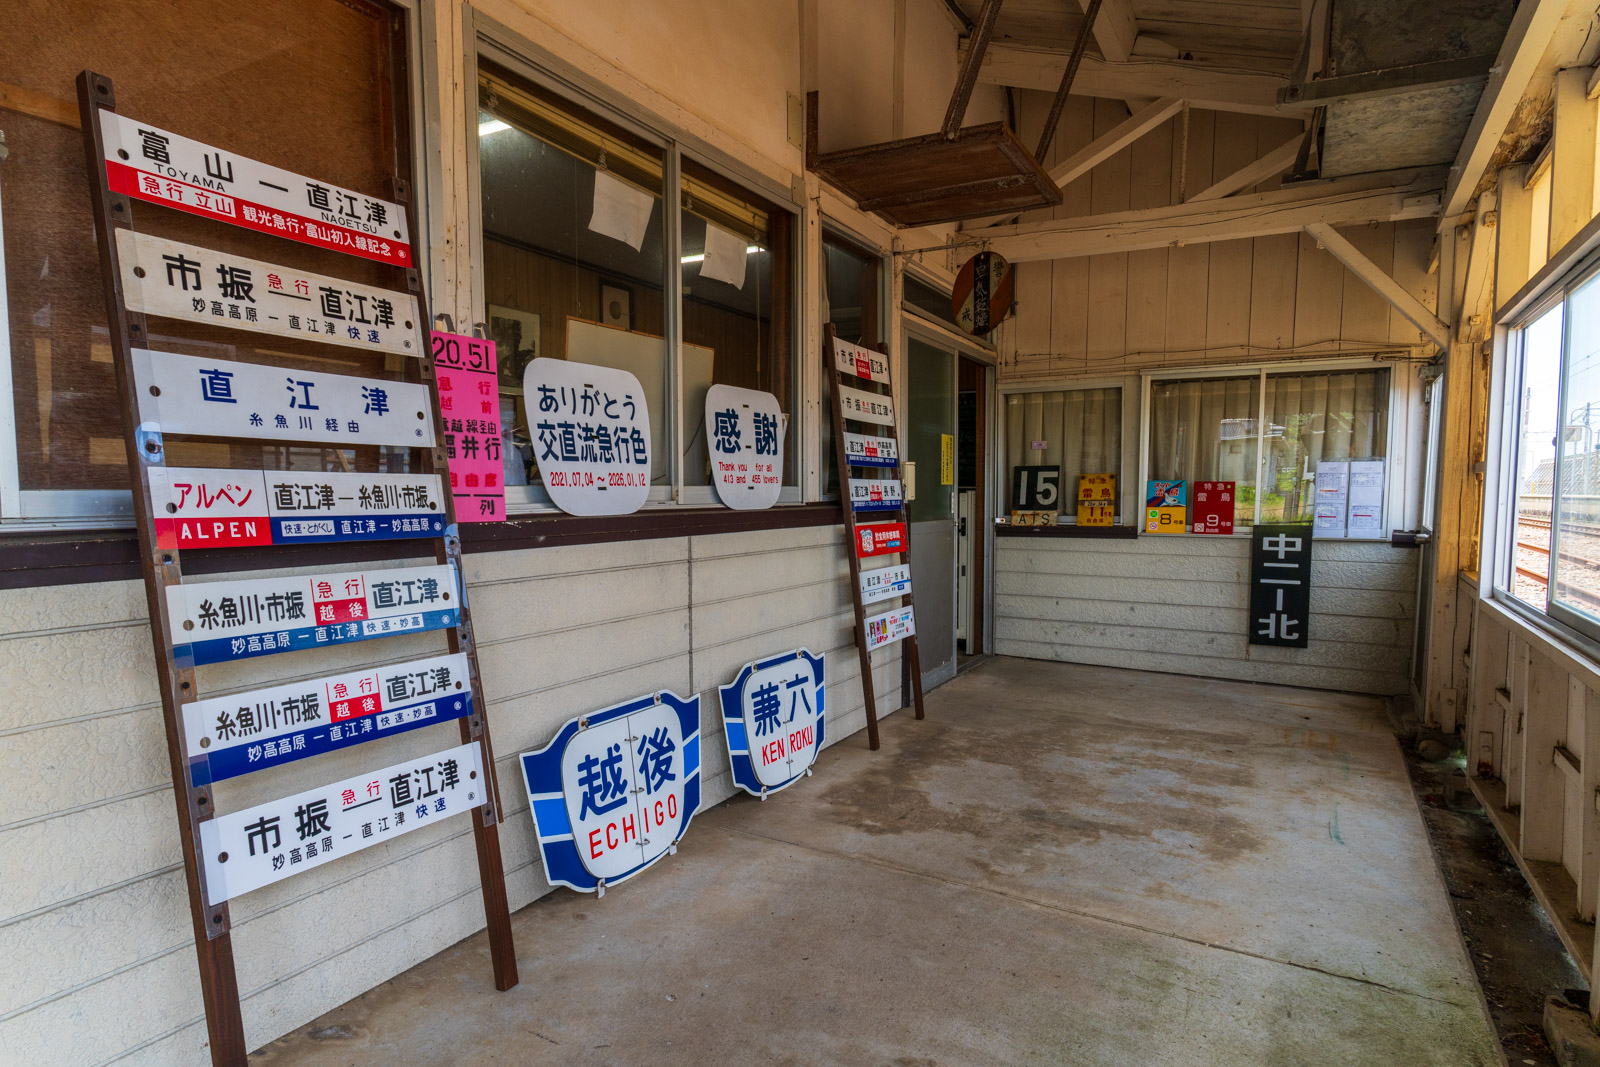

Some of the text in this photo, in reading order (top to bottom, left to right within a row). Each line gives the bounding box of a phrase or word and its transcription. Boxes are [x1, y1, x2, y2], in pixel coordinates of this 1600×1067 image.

[153, 163, 379, 235] TOYAMA NAOETSU
[306, 182, 388, 228] 直江津
[243, 204, 392, 257] 観光急行・富山初入線記念
[162, 253, 395, 329] 市振 急行 直江津
[347, 326, 381, 344] 快速
[432, 336, 490, 371] 20.51
[199, 368, 389, 416] 直江津
[537, 384, 636, 421] ありがとう
[537, 419, 648, 465] 交直流急行色
[713, 408, 778, 456] 感謝
[718, 461, 735, 472] Thank
[738, 464, 748, 472] you
[755, 463, 763, 472] for
[723, 474, 779, 484] 413 and 455 lovers
[173, 483, 253, 510] アルペン
[480, 499, 495, 515] 列
[1019, 470, 1059, 506] 15
[181, 521, 257, 540] ALPEN
[198, 578, 439, 630] 糸魚川・市振 急行 直江津
[319, 602, 364, 621] 越後
[366, 616, 421, 633] 快速・妙高
[215, 667, 452, 741] 糸魚川・市振 急行 直江津
[336, 698, 376, 718] 越後
[380, 705, 434, 726] 快速・妙高
[751, 673, 811, 737] 兼六
[762, 725, 814, 766] KEN ROKU
[578, 726, 676, 821] 越後
[244, 759, 460, 857] 市振 急行 直江津
[415, 797, 447, 819] 快速
[588, 793, 677, 859] ECHIGO
